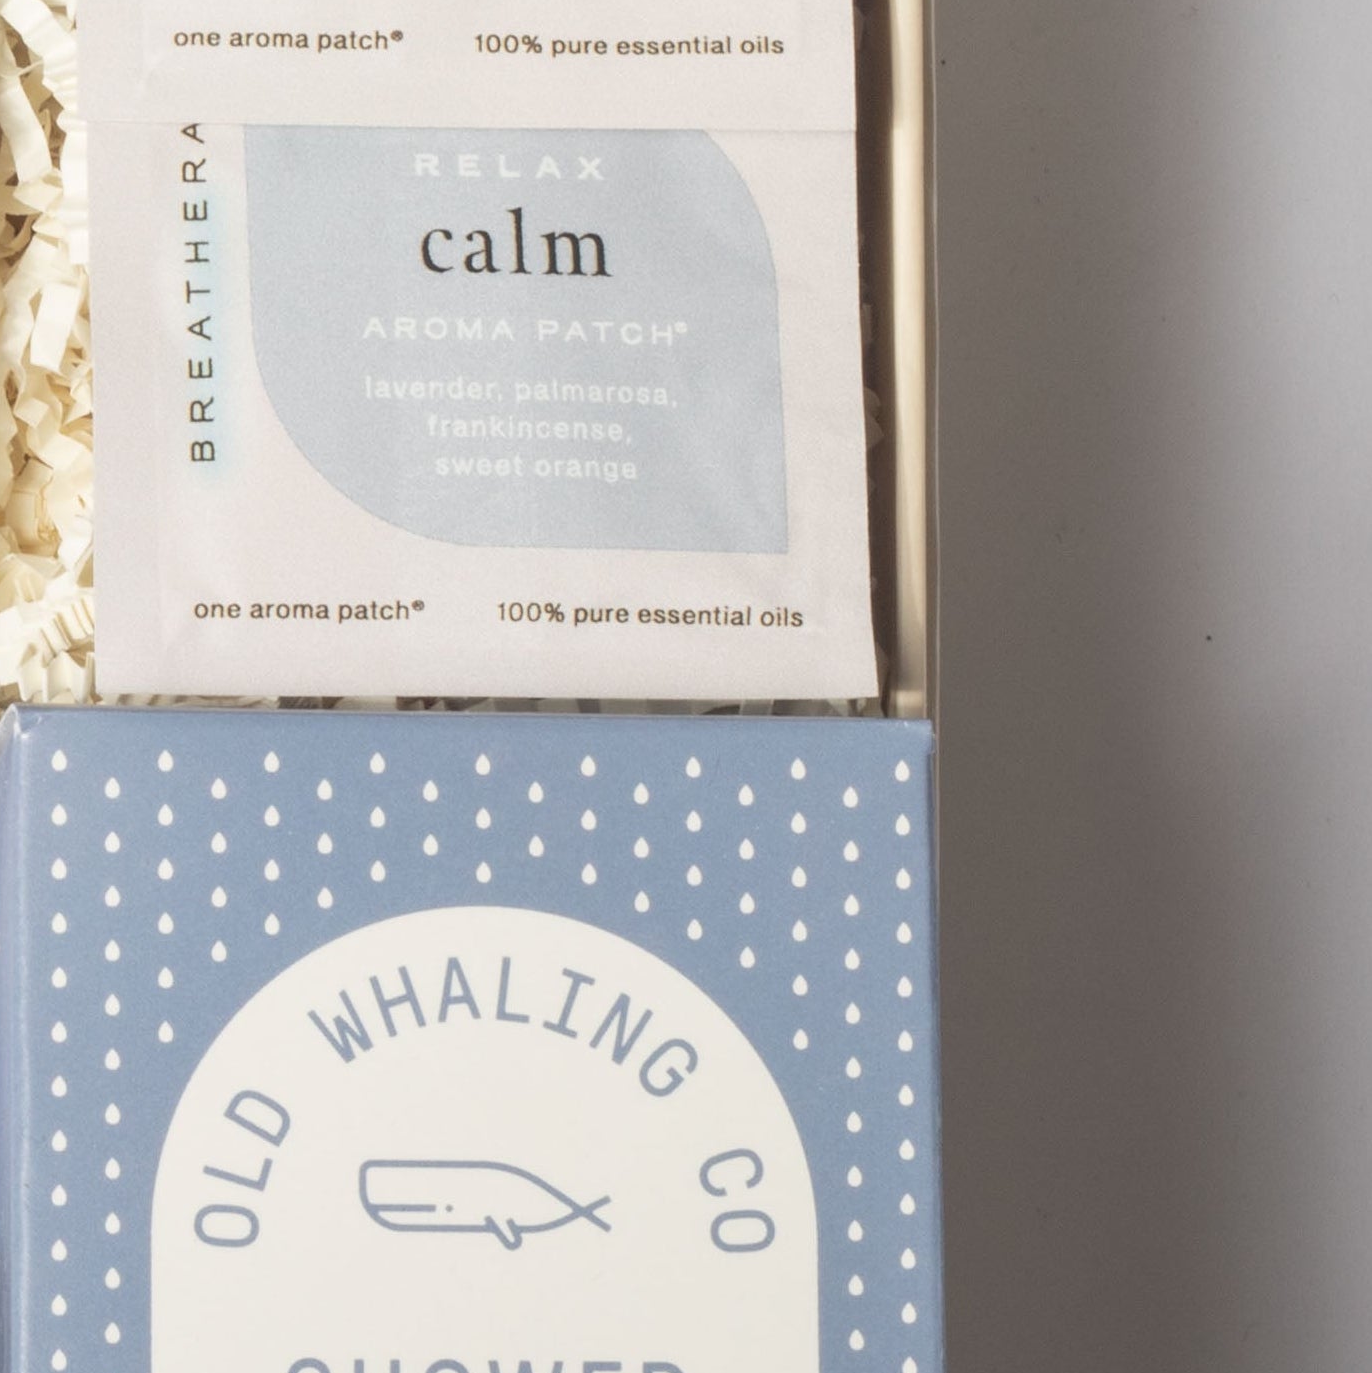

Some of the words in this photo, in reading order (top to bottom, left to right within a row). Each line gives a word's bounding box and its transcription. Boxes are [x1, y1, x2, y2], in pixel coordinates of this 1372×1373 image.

[174, 30, 220, 48] one
[230, 31, 310, 49] aroma
[475, 35, 543, 55] 100%
[551, 37, 608, 58] pure
[617, 35, 731, 56] essential
[740, 37, 784, 55] oils
[415, 154, 605, 181] RELAX
[420, 207, 613, 277] calm
[363, 317, 514, 342] AROMA
[365, 375, 503, 404] lavender,
[516, 381, 678, 409] palmarosa,
[427, 416, 633, 445] frankincense,
[435, 456, 524, 478] sweet
[535, 458, 637, 485] orange
[194, 600, 239, 619] one
[250, 599, 330, 621] aroma
[498, 603, 565, 624] 100%
[574, 606, 629, 627] pure
[638, 604, 752, 626] essential
[761, 606, 804, 627] oils
[193, 1089, 292, 1249] OLD
[307, 955, 699, 1098] WHALING
[699, 1148, 776, 1254] CO
